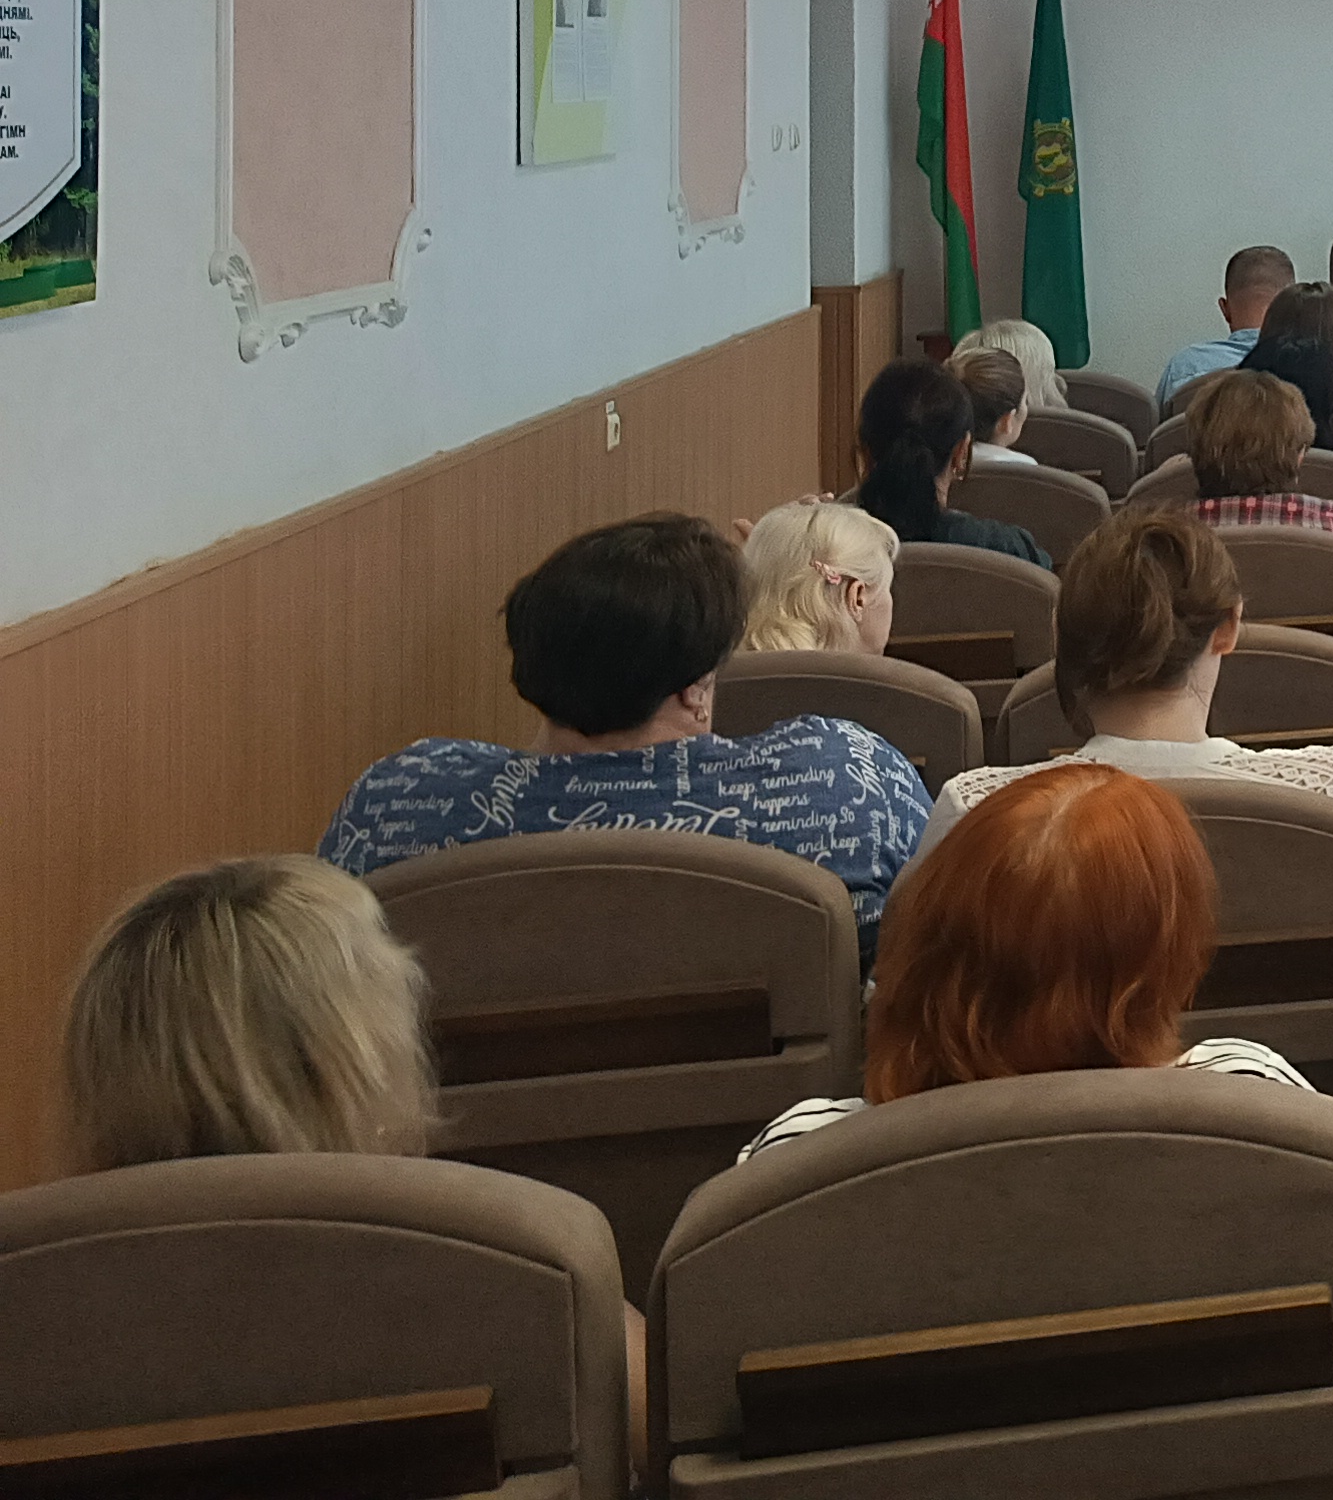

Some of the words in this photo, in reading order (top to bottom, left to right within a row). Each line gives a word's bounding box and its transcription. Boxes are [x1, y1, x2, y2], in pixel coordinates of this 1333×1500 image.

[565, 774, 659, 797] reminding
[718, 780, 755, 801] keep
[762, 765, 835, 788] reminding
[753, 792, 811, 817] happens
[761, 811, 838, 833] reminding
[840, 806, 856, 825] So
[797, 835, 828, 855] and
[830, 833, 861, 857] keep
